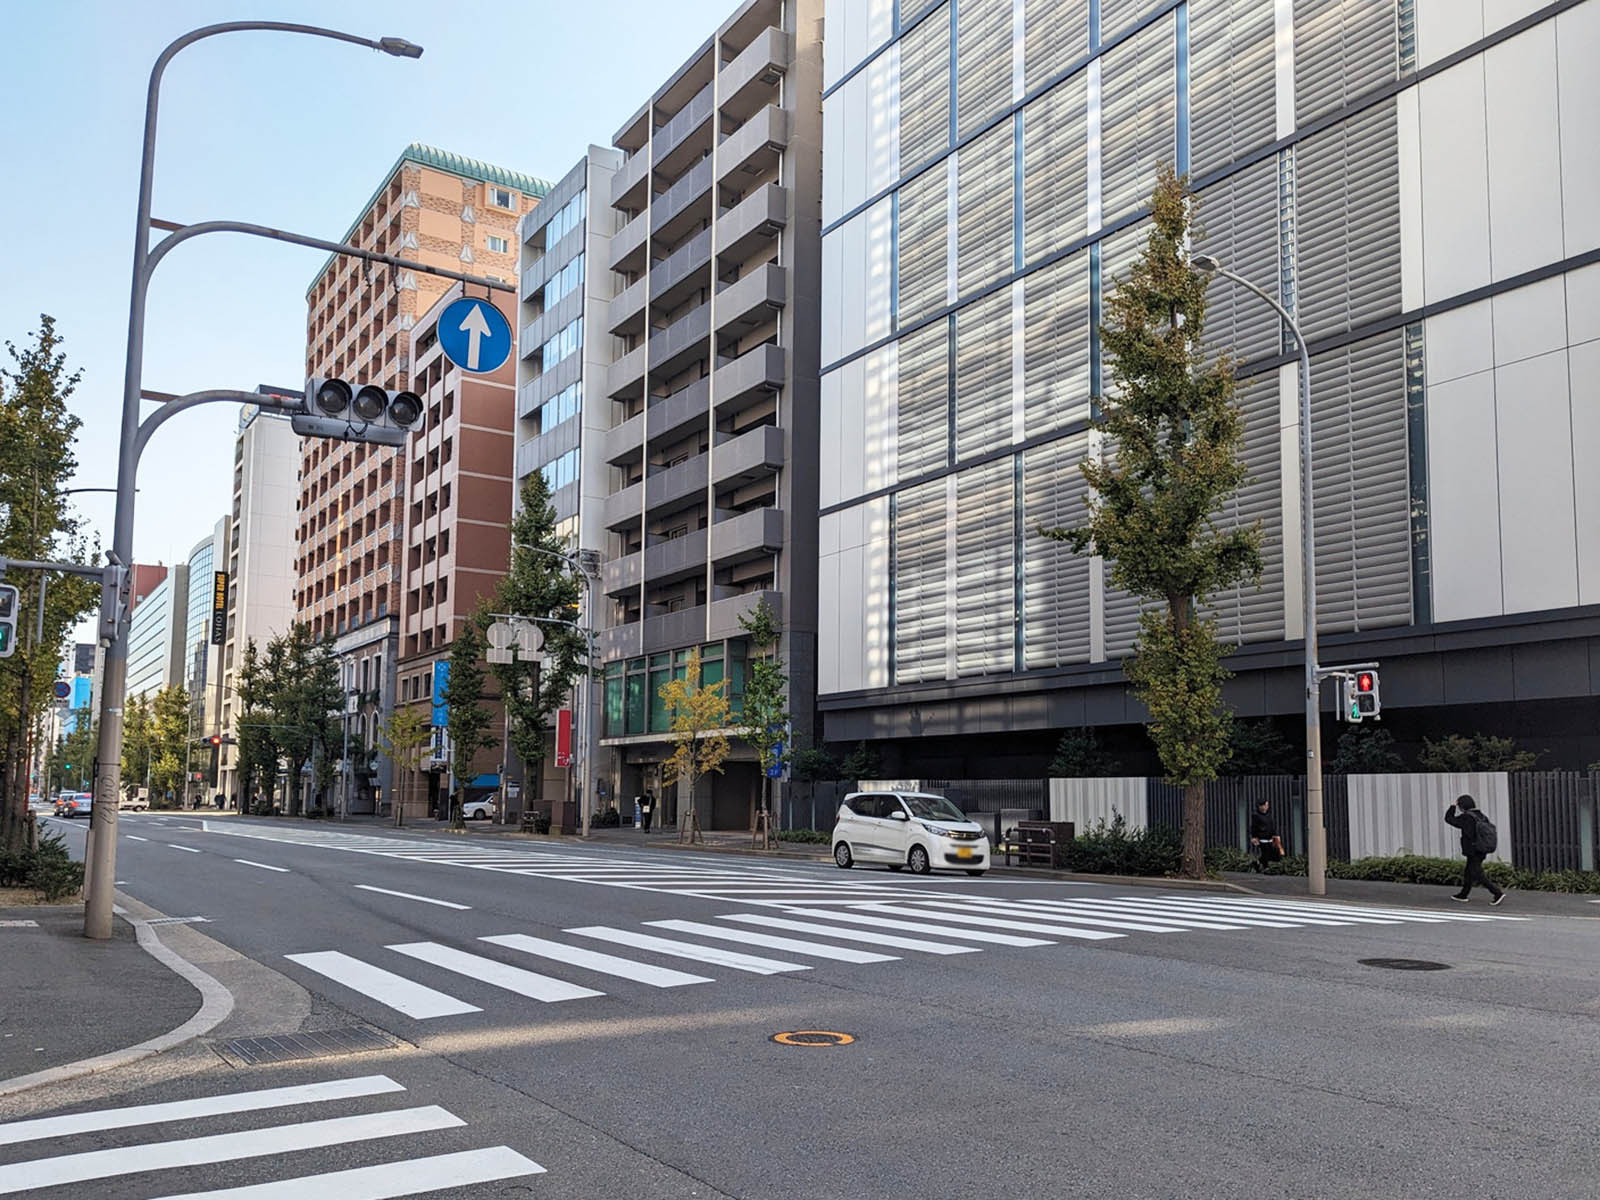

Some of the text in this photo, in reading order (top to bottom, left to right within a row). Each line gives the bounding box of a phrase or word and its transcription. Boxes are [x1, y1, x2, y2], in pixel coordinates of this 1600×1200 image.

[215, 573, 225, 643] SUPER HOTEL LOHAS
